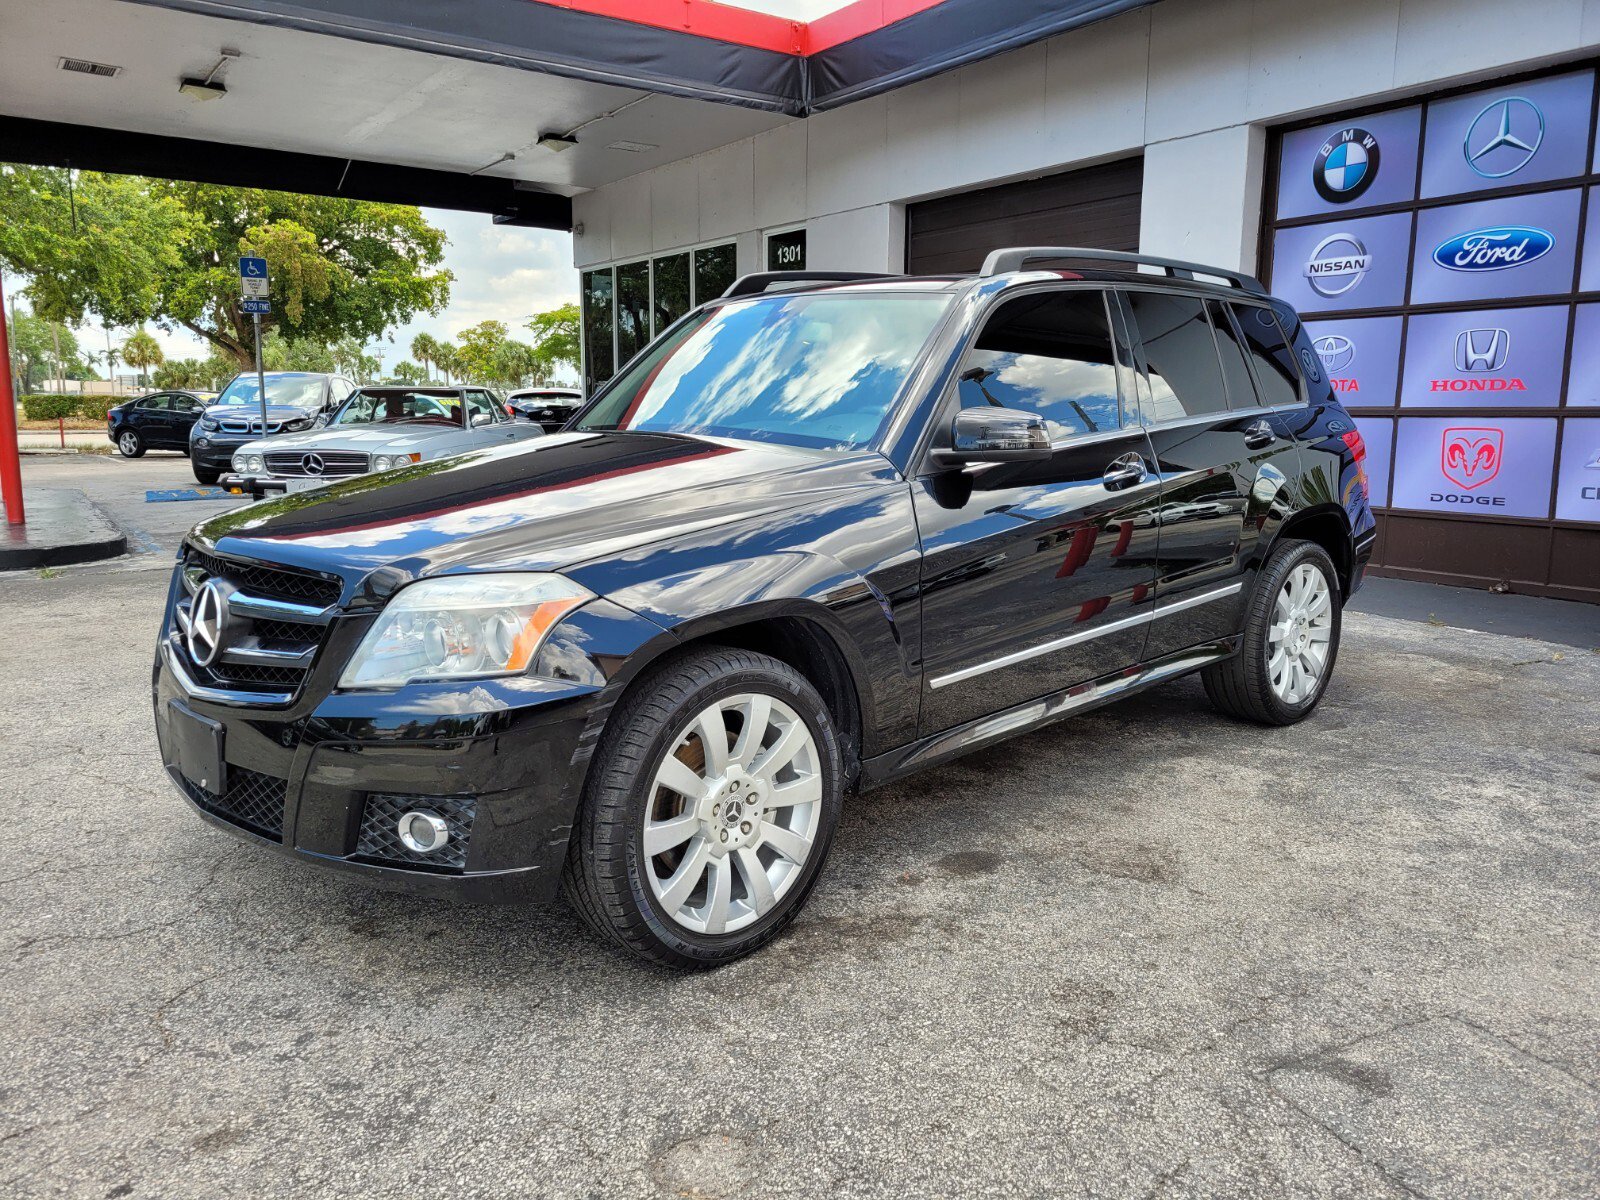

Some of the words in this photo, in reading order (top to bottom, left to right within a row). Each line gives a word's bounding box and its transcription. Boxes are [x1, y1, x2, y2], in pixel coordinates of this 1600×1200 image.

[1320, 129, 1376, 157] BMW
[777, 244, 801, 264] 1301
[1454, 233, 1529, 265] Ford
[1309, 259, 1365, 274] NISSAN
[1430, 378, 1528, 392] HONDA
[1430, 493, 1506, 506] DODGE
